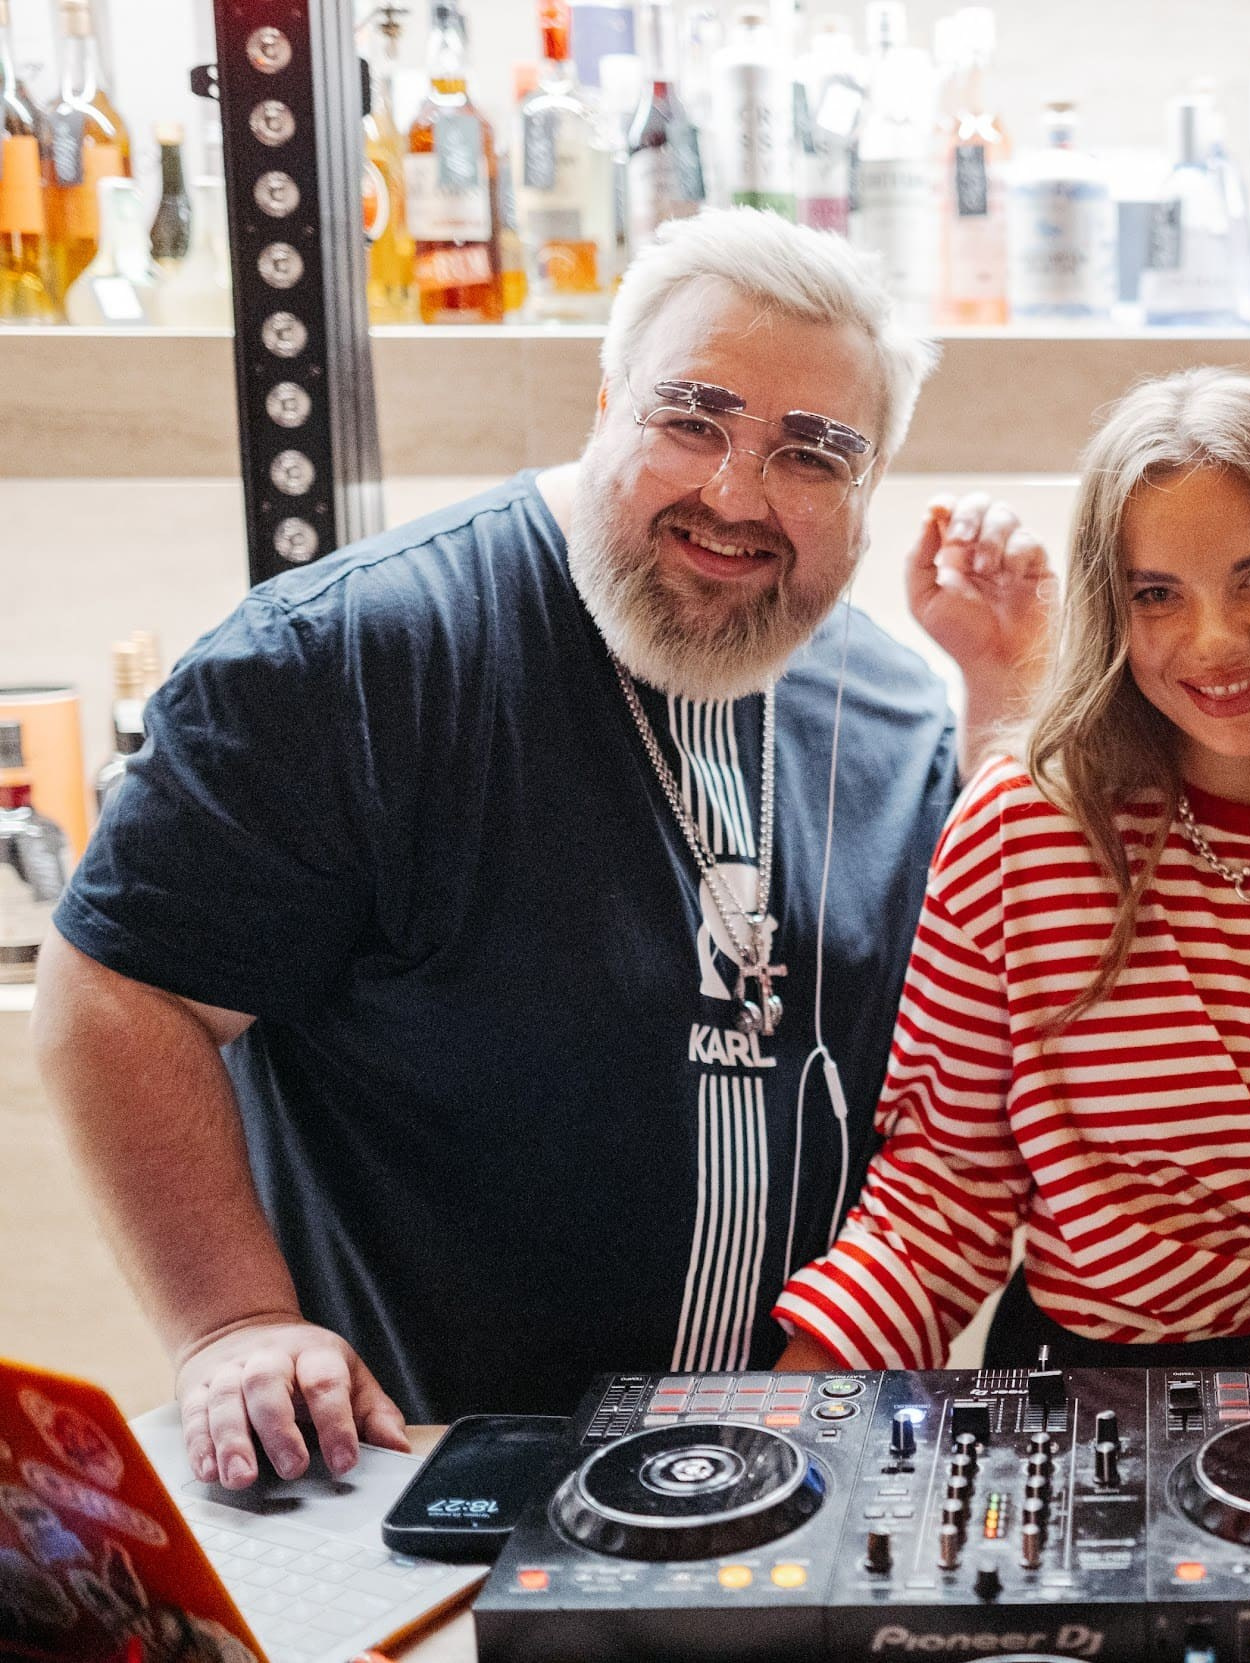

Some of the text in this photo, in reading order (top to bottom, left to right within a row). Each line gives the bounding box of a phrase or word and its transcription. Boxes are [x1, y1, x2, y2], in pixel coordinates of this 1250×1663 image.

[689, 1023, 777, 1067] KARL
[427, 1500, 497, 1512] 18:27
[872, 1624, 1047, 1653] Pioneer
